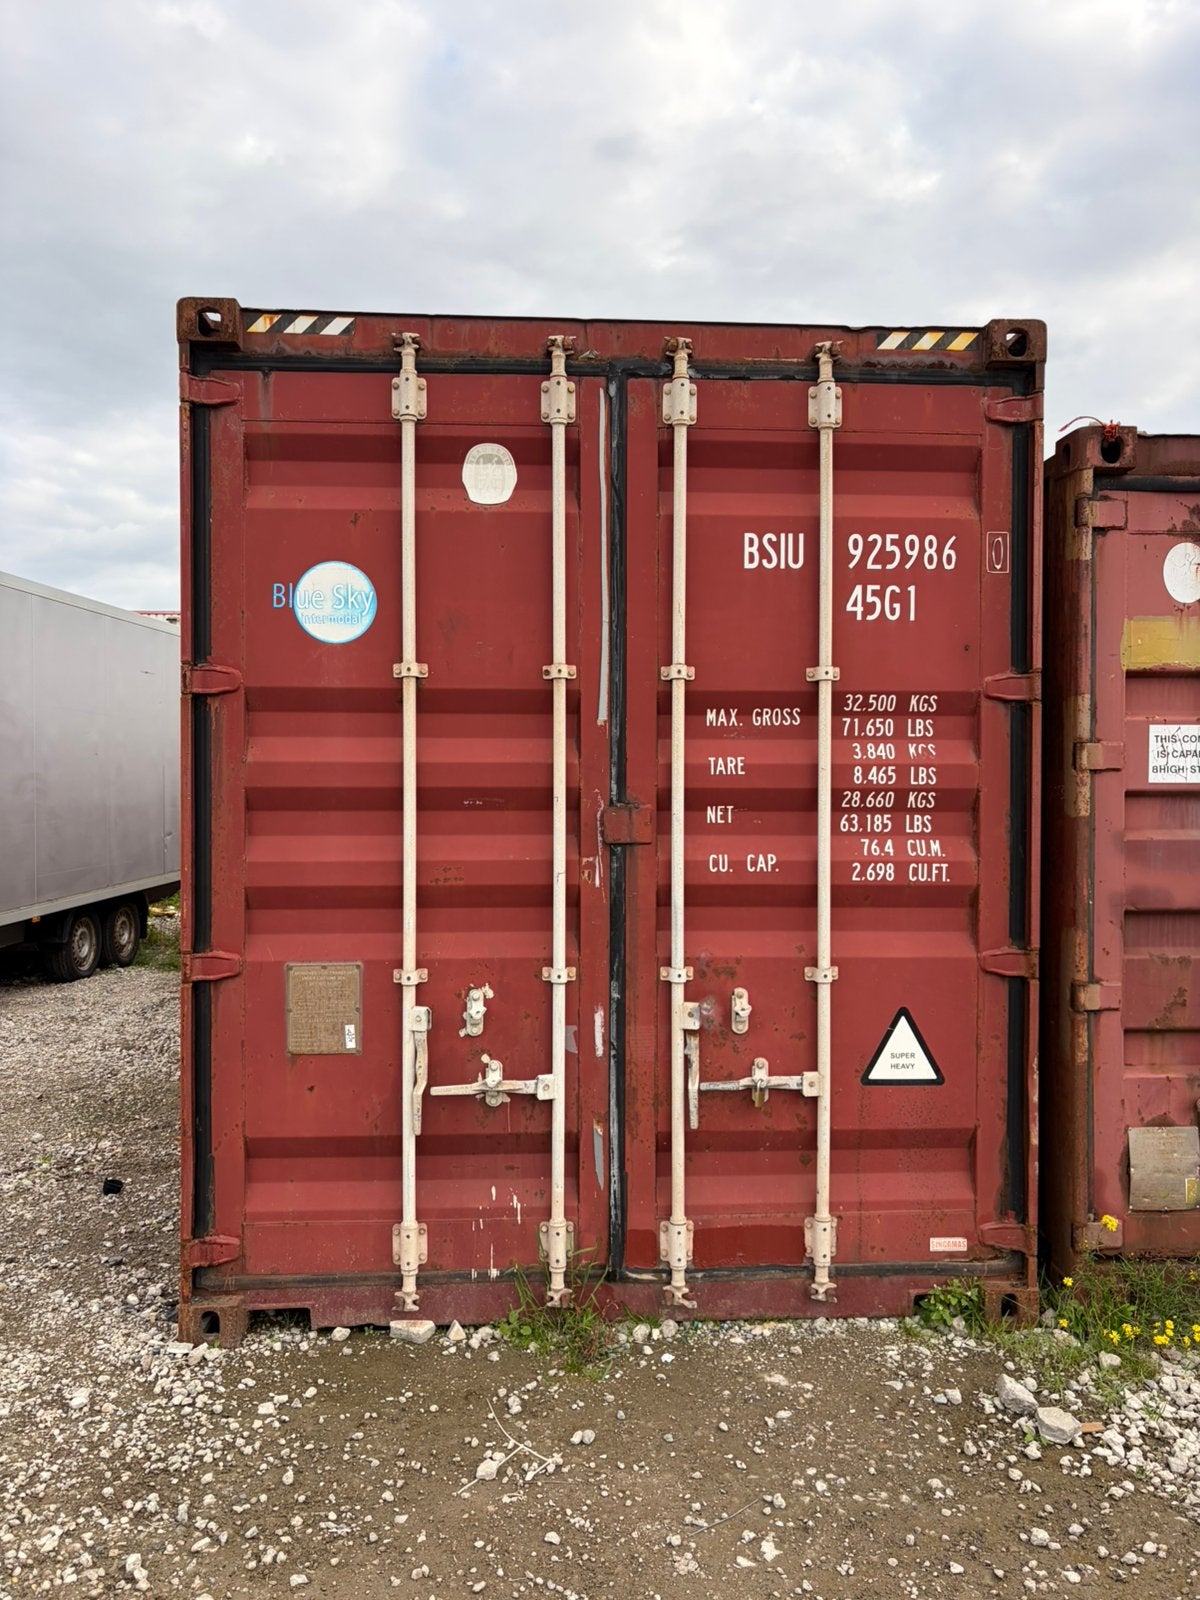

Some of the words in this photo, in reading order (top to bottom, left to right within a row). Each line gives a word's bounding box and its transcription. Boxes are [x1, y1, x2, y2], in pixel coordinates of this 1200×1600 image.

[743, 532, 804, 570] BSIU
[847, 533, 957, 570] 925986
[272, 583, 324, 609] Blue
[333, 583, 374, 616] Sky
[845, 584, 916, 622] 45G1
[909, 694, 938, 712] KGS
[706, 708, 743, 727] MAX.
[752, 707, 801, 726] GROSS
[907, 718, 934, 737] LBS
[1154, 734, 1177, 743] THIS
[1156, 750, 1167, 759] IS
[1171, 749, 1200, 759] CAPA
[708, 756, 746, 775] TARE
[1151, 764, 1185, 774] 8HIGH
[910, 766, 937, 785] LBS
[907, 791, 936, 809] KGS
[706, 805, 734, 824] NET
[905, 814, 932, 833] LBS
[860, 838, 894, 857] 76.4
[906, 839, 946, 857] CU.M.
[709, 854, 733, 873] CU.
[746, 853, 780, 873] CAP.
[908, 863, 951, 882] CU.FT.
